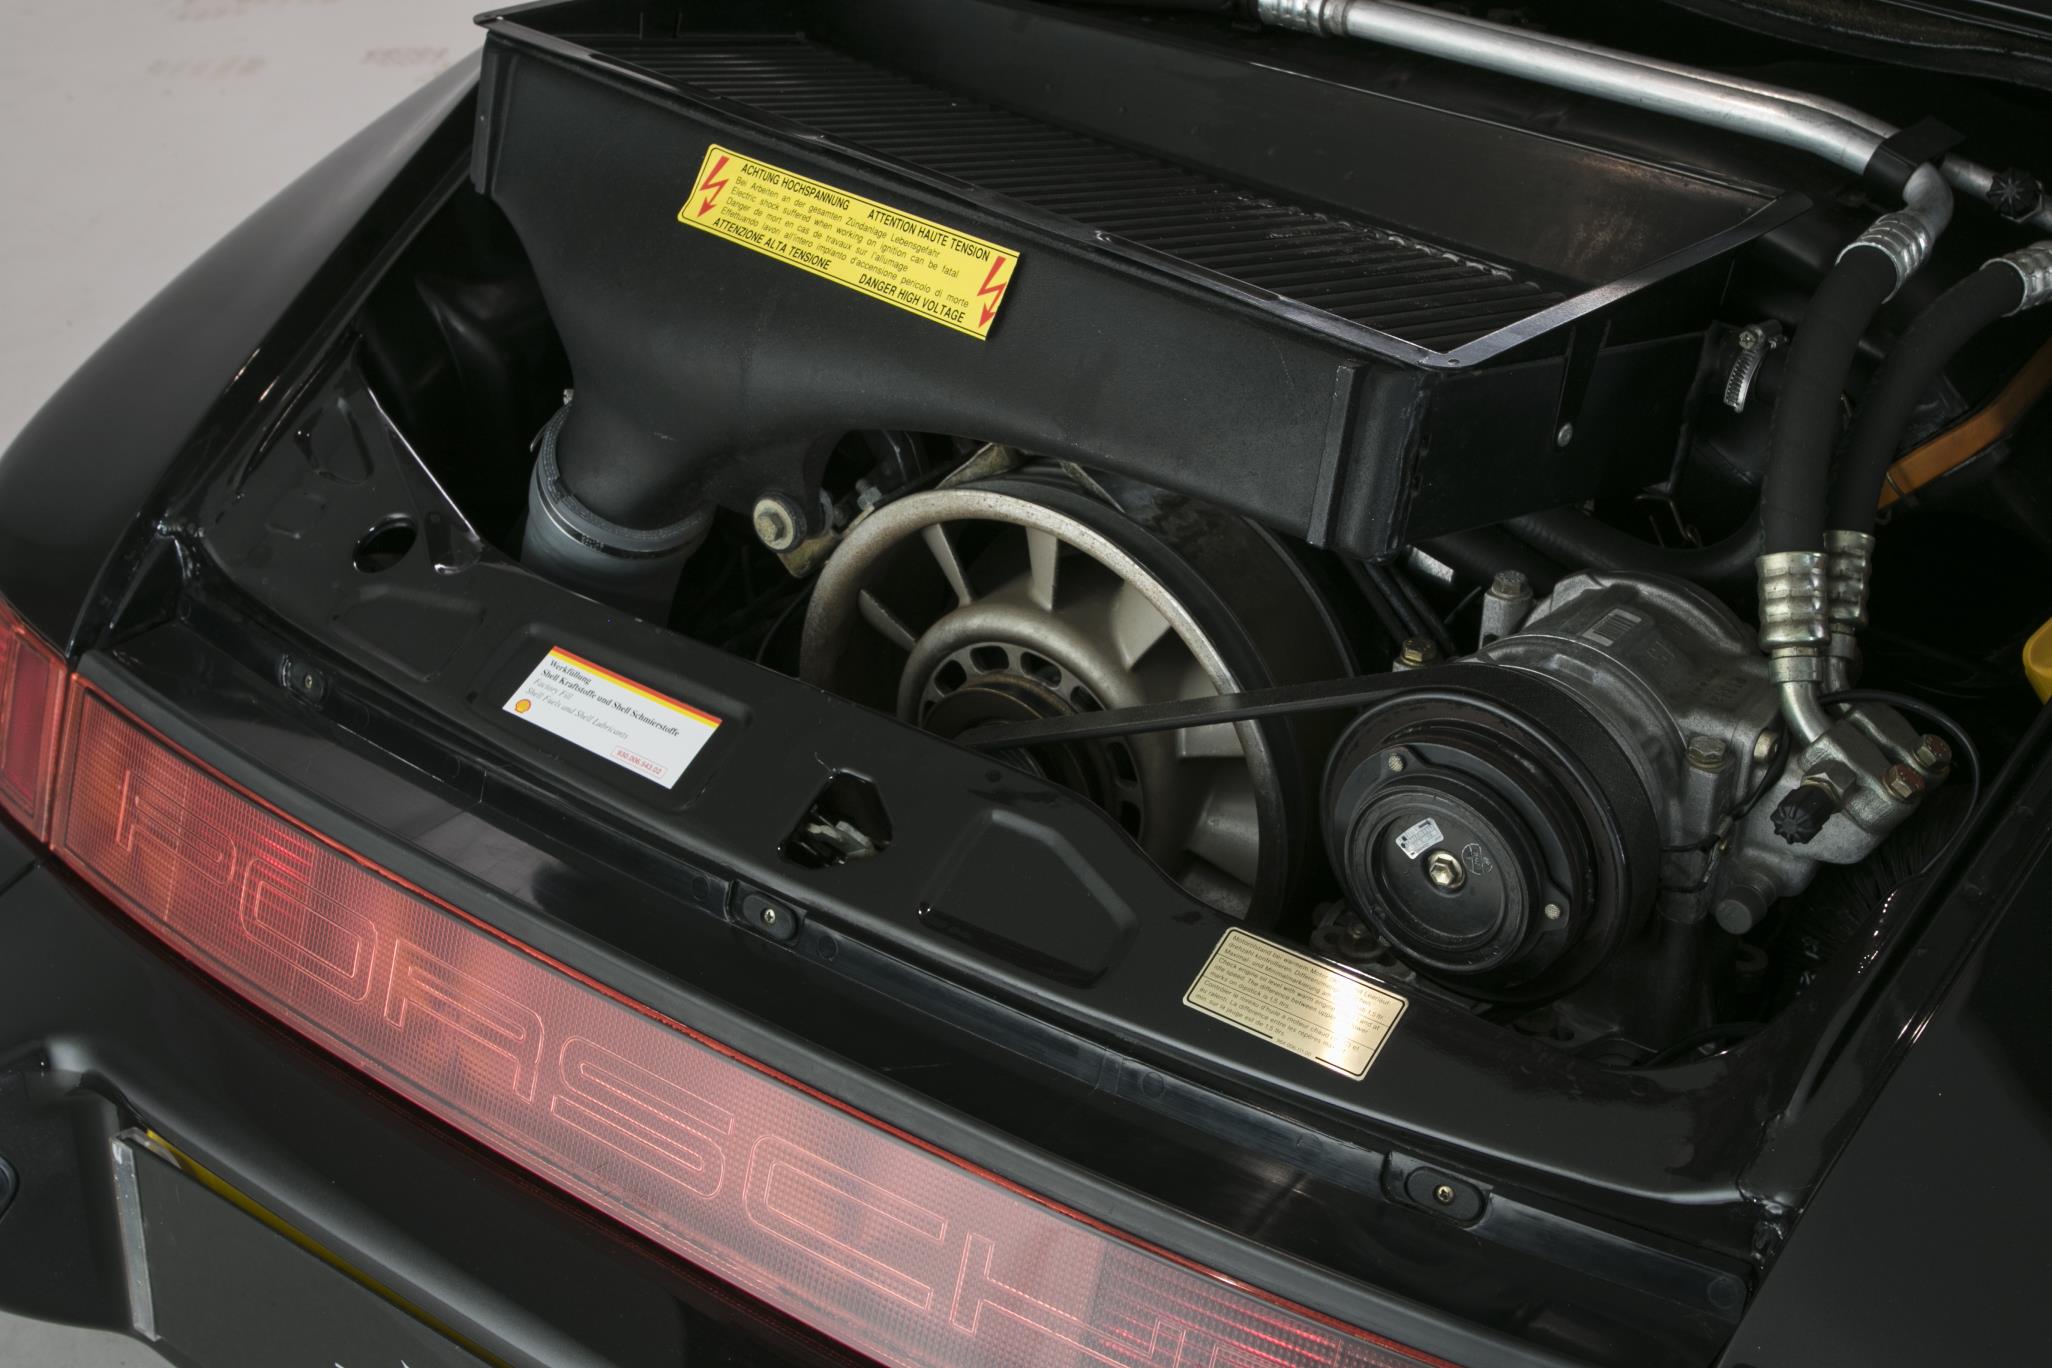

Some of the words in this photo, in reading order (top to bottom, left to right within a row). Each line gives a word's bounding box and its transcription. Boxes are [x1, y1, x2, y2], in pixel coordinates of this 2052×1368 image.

[740, 162, 781, 185] ACHTUNG
[780, 176, 851, 211] HOCHSPANNUNG
[712, 216, 765, 244] ATTENZIONE
[763, 236, 788, 253] ALTA
[787, 245, 832, 270] TENSIONE
[724, 196, 751, 214] Danger
[752, 207, 764, 217] de
[764, 211, 782, 224] mort
[784, 218, 795, 229] en
[796, 223, 811, 235] cas
[811, 229, 823, 239] de
[824, 234, 852, 250] travaux
[854, 245, 867, 256] sur
[869, 251, 909, 273] l'allumage
[730, 186, 757, 202] Electric
[758, 197, 781, 211] shock
[781, 205, 811, 223] suffered
[813, 217, 833, 231] when
[834, 225, 864, 244] working
[865, 236, 878, 247] on
[878, 241, 908, 260] ignition
[909, 252, 925, 265] can
[927, 259, 939, 270] be
[940, 264, 960, 278] fatal
[734, 176, 748, 187] Bei
[749, 181, 780, 199] Arbeiten
[780, 192, 792, 203] an
[793, 197, 806, 209] der
[807, 202, 843, 223] gesamten
[844, 216, 888, 240] Zündanlage
[889, 232, 941, 259] Lebensgefahr
[866, 208, 917, 235] ATTENTION
[916, 226, 949, 246] HAUTE
[948, 237, 991, 262] TENSION
[720, 206, 759, 227] Effettuando
[761, 222, 782, 236] lavori
[783, 230, 814, 248] all'intero
[815, 243, 847, 262] impianto
[849, 256, 898, 280] d'accensione
[899, 275, 932, 294] pericolo
[933, 288, 943, 297] di
[945, 292, 969, 308] morte
[858, 273, 897, 296] DANGER
[896, 287, 921, 305] HIGH
[921, 297, 966, 323] VOLTAGE
[534, 678, 559, 694] Factory
[559, 689, 573, 700] Fill
[549, 659, 591, 684] Werkfüllung
[526, 686, 544, 699] Shell
[561, 702, 577, 714] and
[575, 709, 594, 723] Shell
[542, 668, 560, 681] Shell
[560, 676, 598, 698] Kraftstoffe
[597, 693, 613, 705] und
[613, 700, 632, 714] Shell
[630, 708, 681, 737] Schmierstoffe
[115, 768, 1275, 1368] PORSCH
